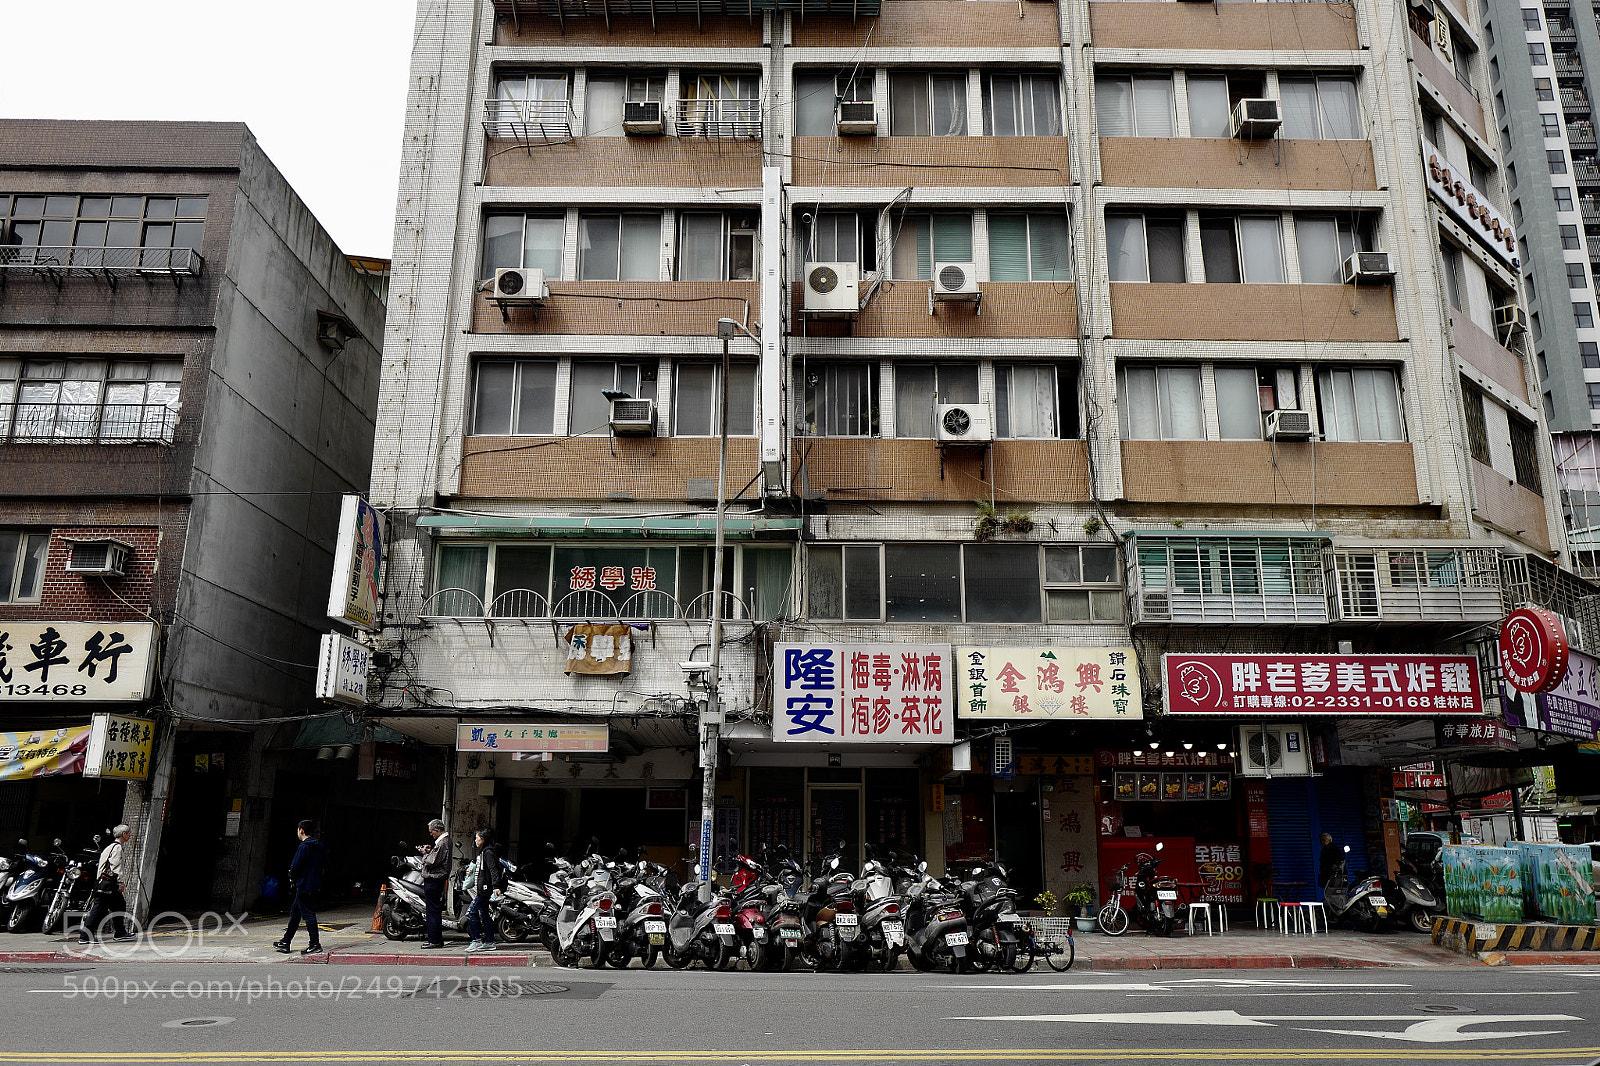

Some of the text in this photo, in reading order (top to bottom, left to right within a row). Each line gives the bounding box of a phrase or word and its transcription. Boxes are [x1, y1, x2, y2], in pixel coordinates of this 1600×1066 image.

[570, 566, 656, 590] 綉學號
[967, 651, 988, 713] 金銀首飾
[995, 661, 1104, 693] 金鴻興
[1108, 651, 1130, 715] 鑽石珠寶
[1231, 661, 1472, 694] 胖老爹美式炸雞
[0, 684, 88, 696] 13468
[784, 648, 836, 736] 隆安
[1433, 695, 1475, 709] 桂林店
[108, 720, 151, 746] 各種機車
[470, 727, 499, 748] 凱麗
[1442, 723, 1496, 739] 帝華旅店
[104, 749, 148, 775] 修理買賣
[1195, 845, 1242, 863] 全家餐
[1214, 866, 1244, 881] 289
